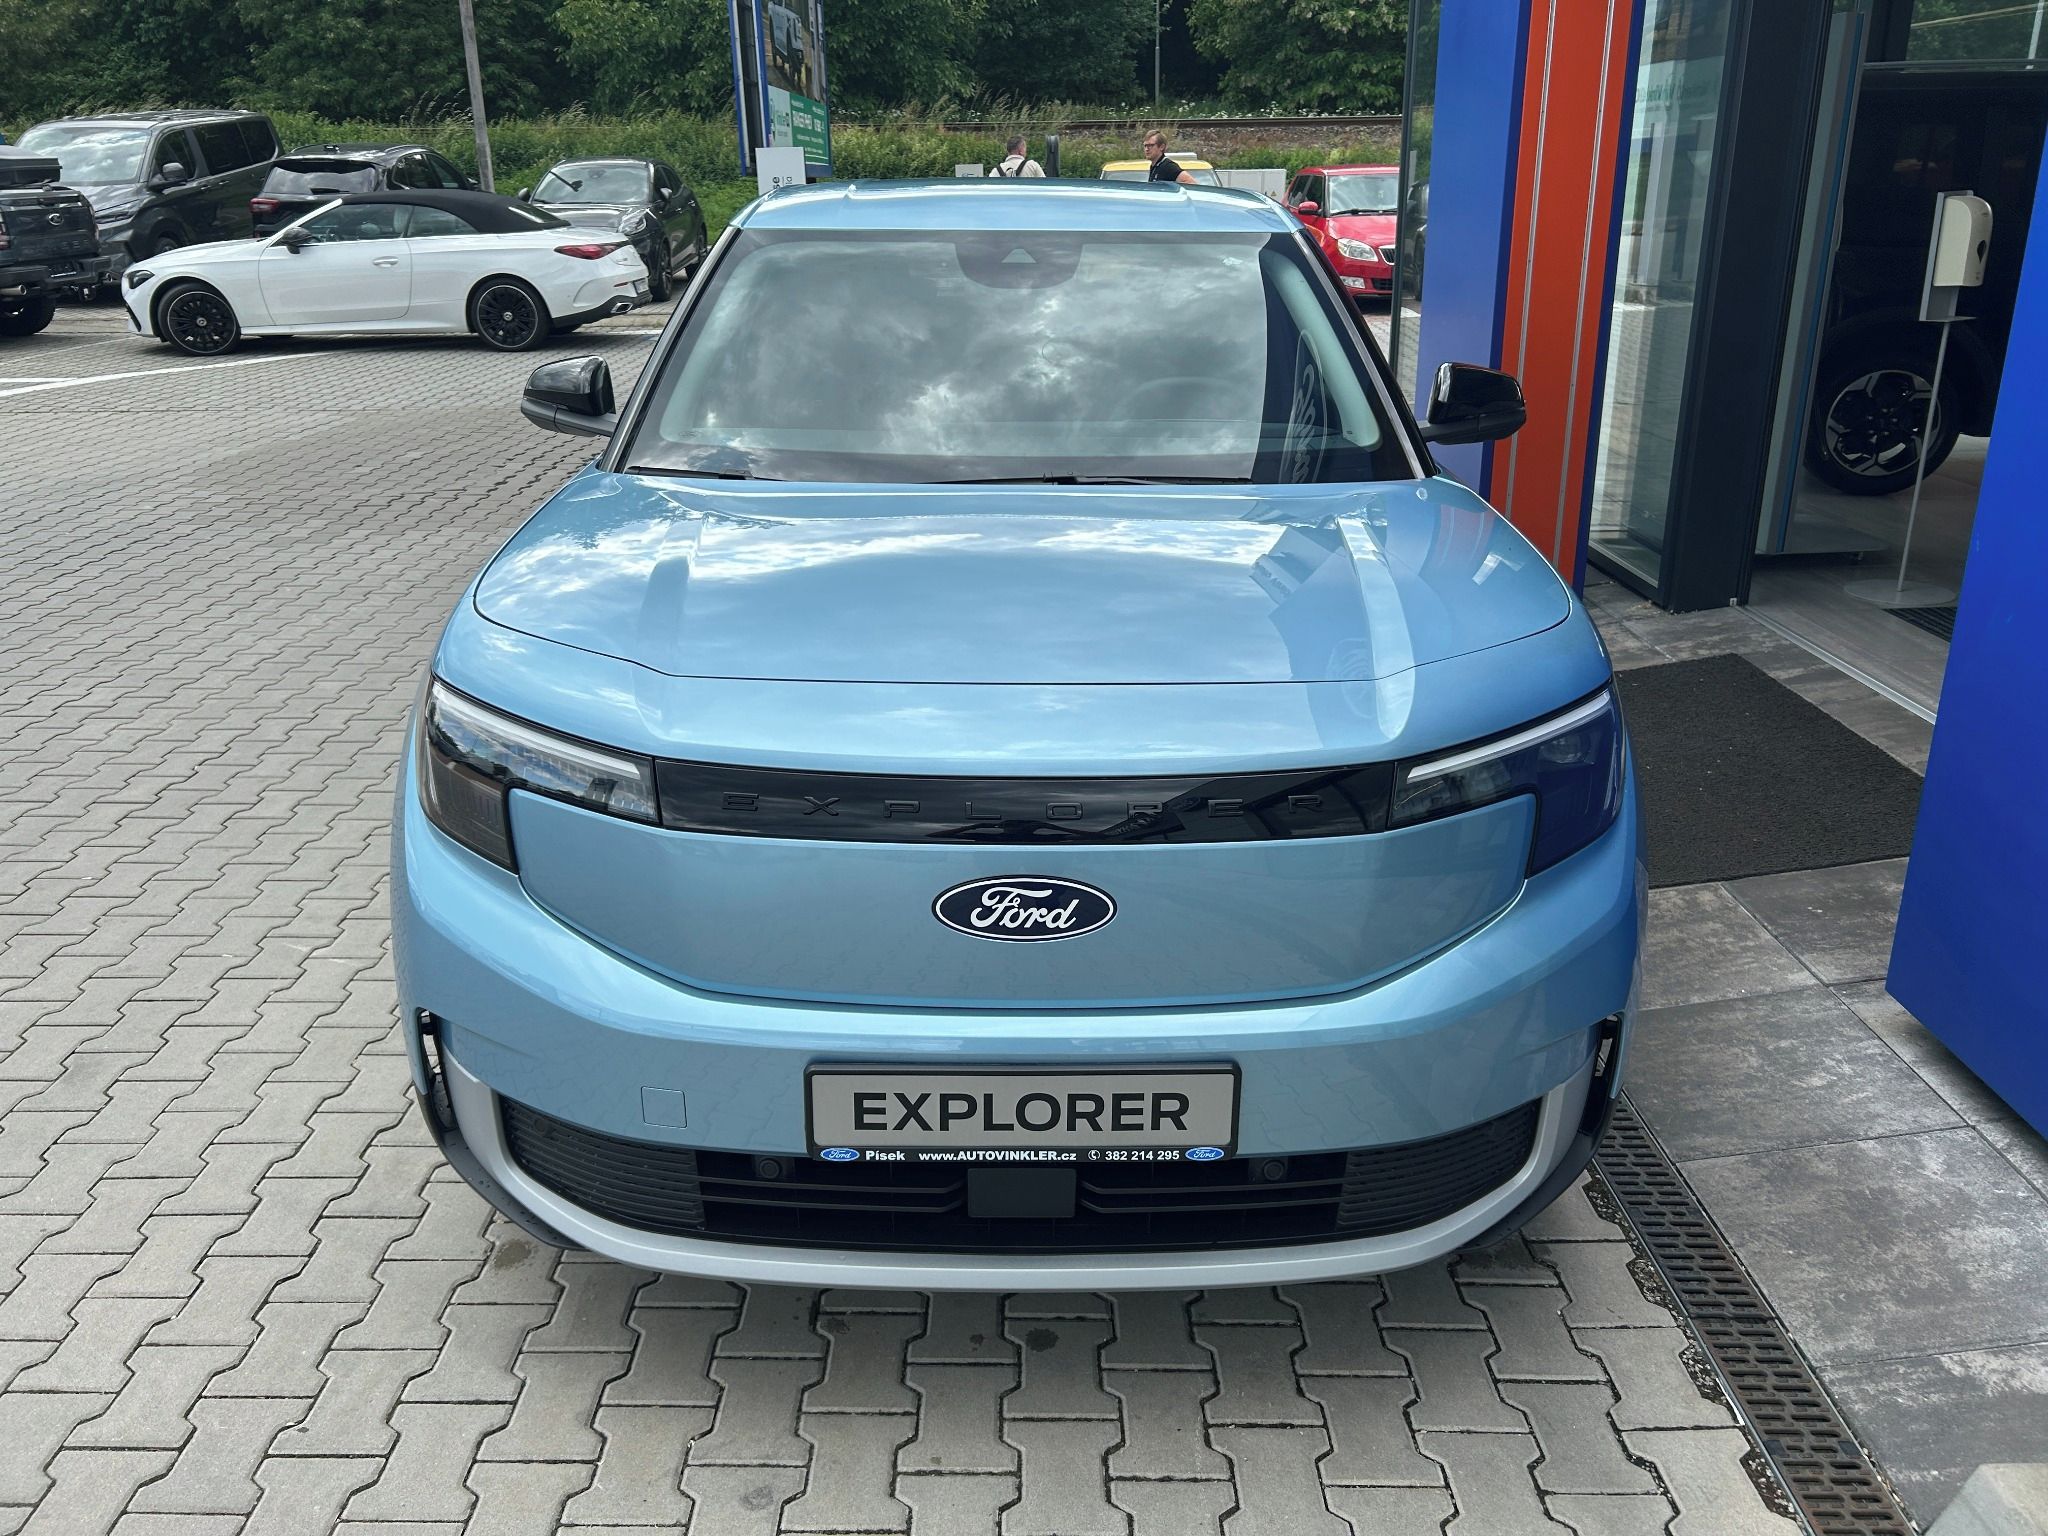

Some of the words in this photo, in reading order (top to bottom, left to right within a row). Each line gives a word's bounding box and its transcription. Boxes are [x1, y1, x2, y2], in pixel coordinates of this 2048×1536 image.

[722, 791, 1323, 820] EXPLORER
[970, 886, 1080, 929] Ford
[853, 1092, 1190, 1132] EXPLORER
[865, 1150, 906, 1160] Písek
[918, 1150, 1077, 1161] www.AUTOVINKLER.cz
[1105, 1150, 1128, 1160] 382
[1131, 1150, 1154, 1160] 214
[1156, 1150, 1180, 1160] 295
